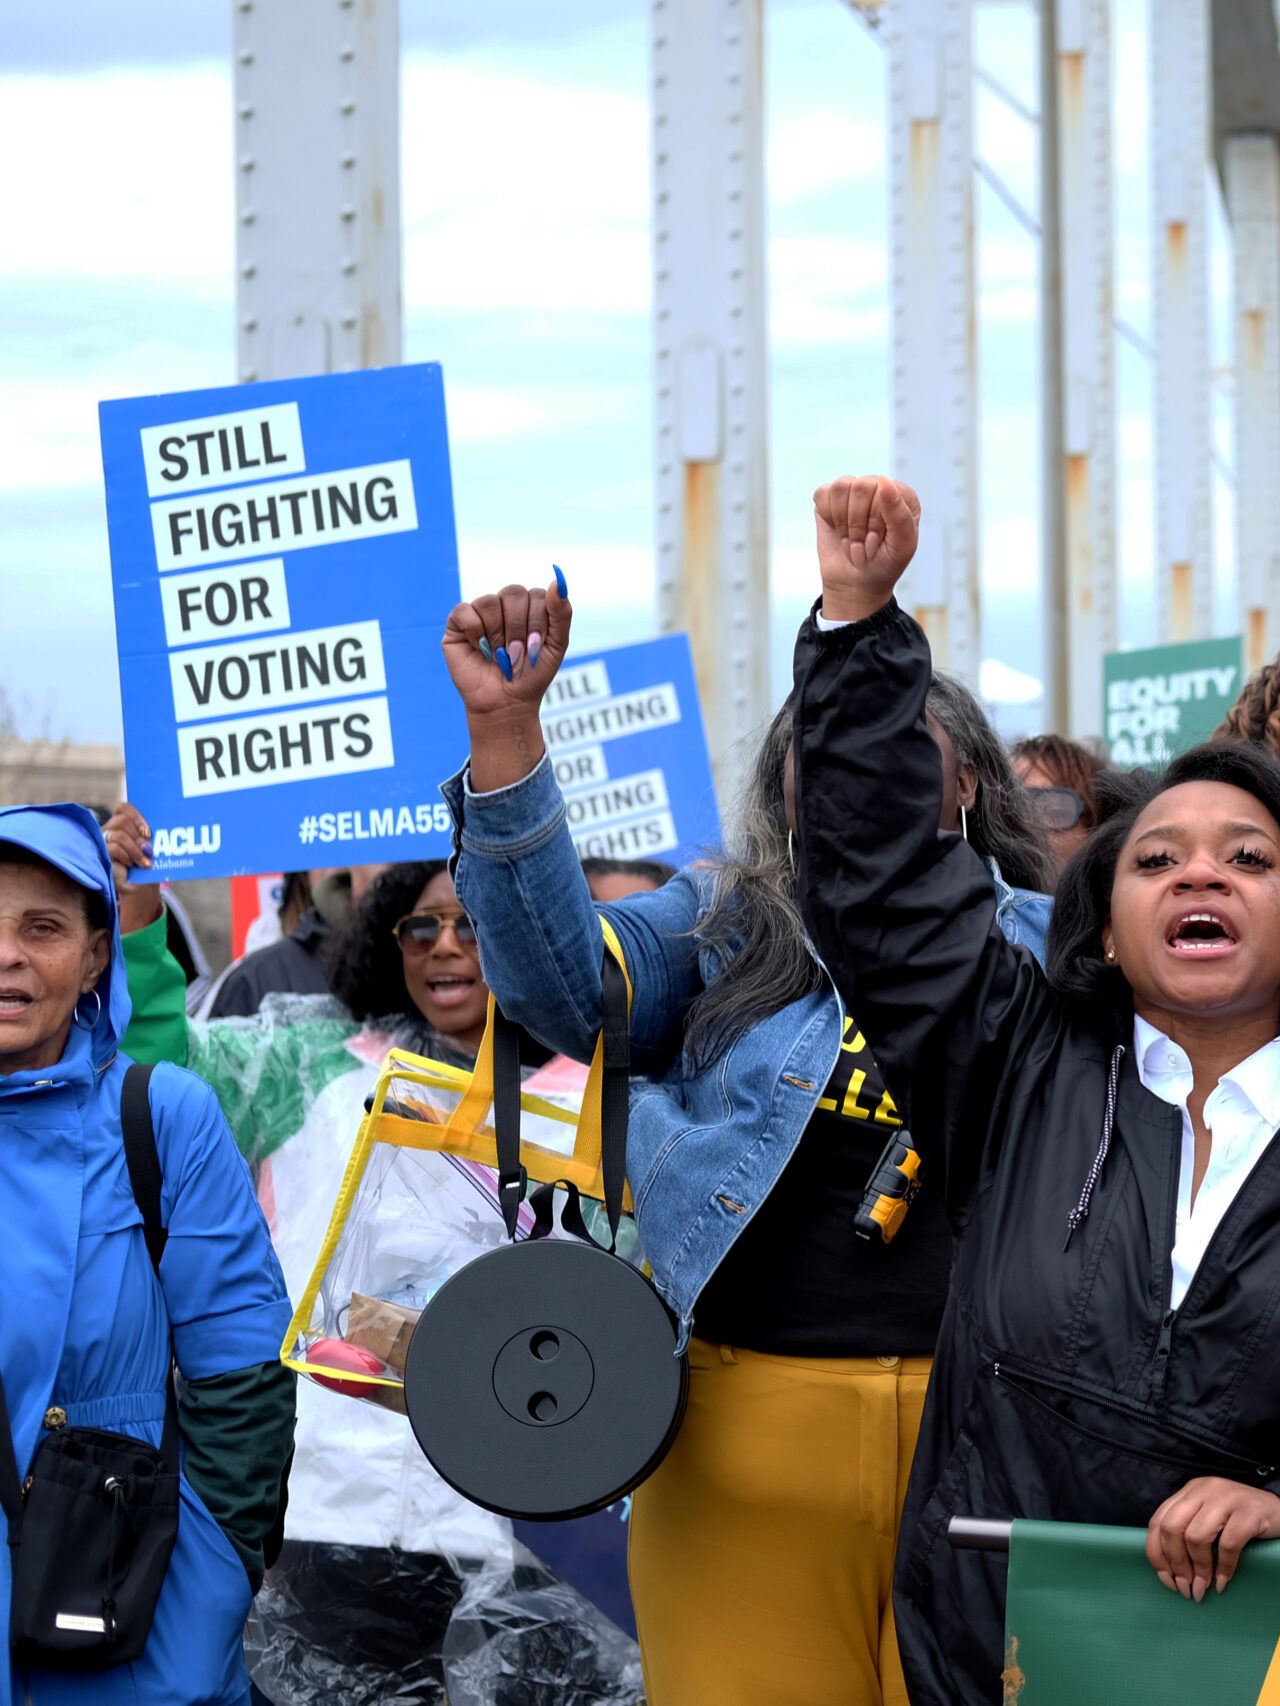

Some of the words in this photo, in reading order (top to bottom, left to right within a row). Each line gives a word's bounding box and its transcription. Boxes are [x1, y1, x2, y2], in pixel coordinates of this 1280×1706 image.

[157, 420, 288, 482] STILL
[168, 476, 399, 556] FIGHTING
[177, 575, 273, 632] FOR
[184, 636, 368, 706] VOTING
[1108, 666, 1237, 710] EQUITY
[547, 693, 668, 745] IGHTING
[1108, 704, 1181, 742] FOR
[195, 712, 374, 782] RIGHTS
[554, 755, 595, 785] OR
[300, 803, 451, 845] #SELMA55
[566, 780, 656, 824] OTING
[153, 823, 221, 857] ACLU
[576, 820, 663, 861] IGHTS
[152, 857, 194, 870] Alabama
